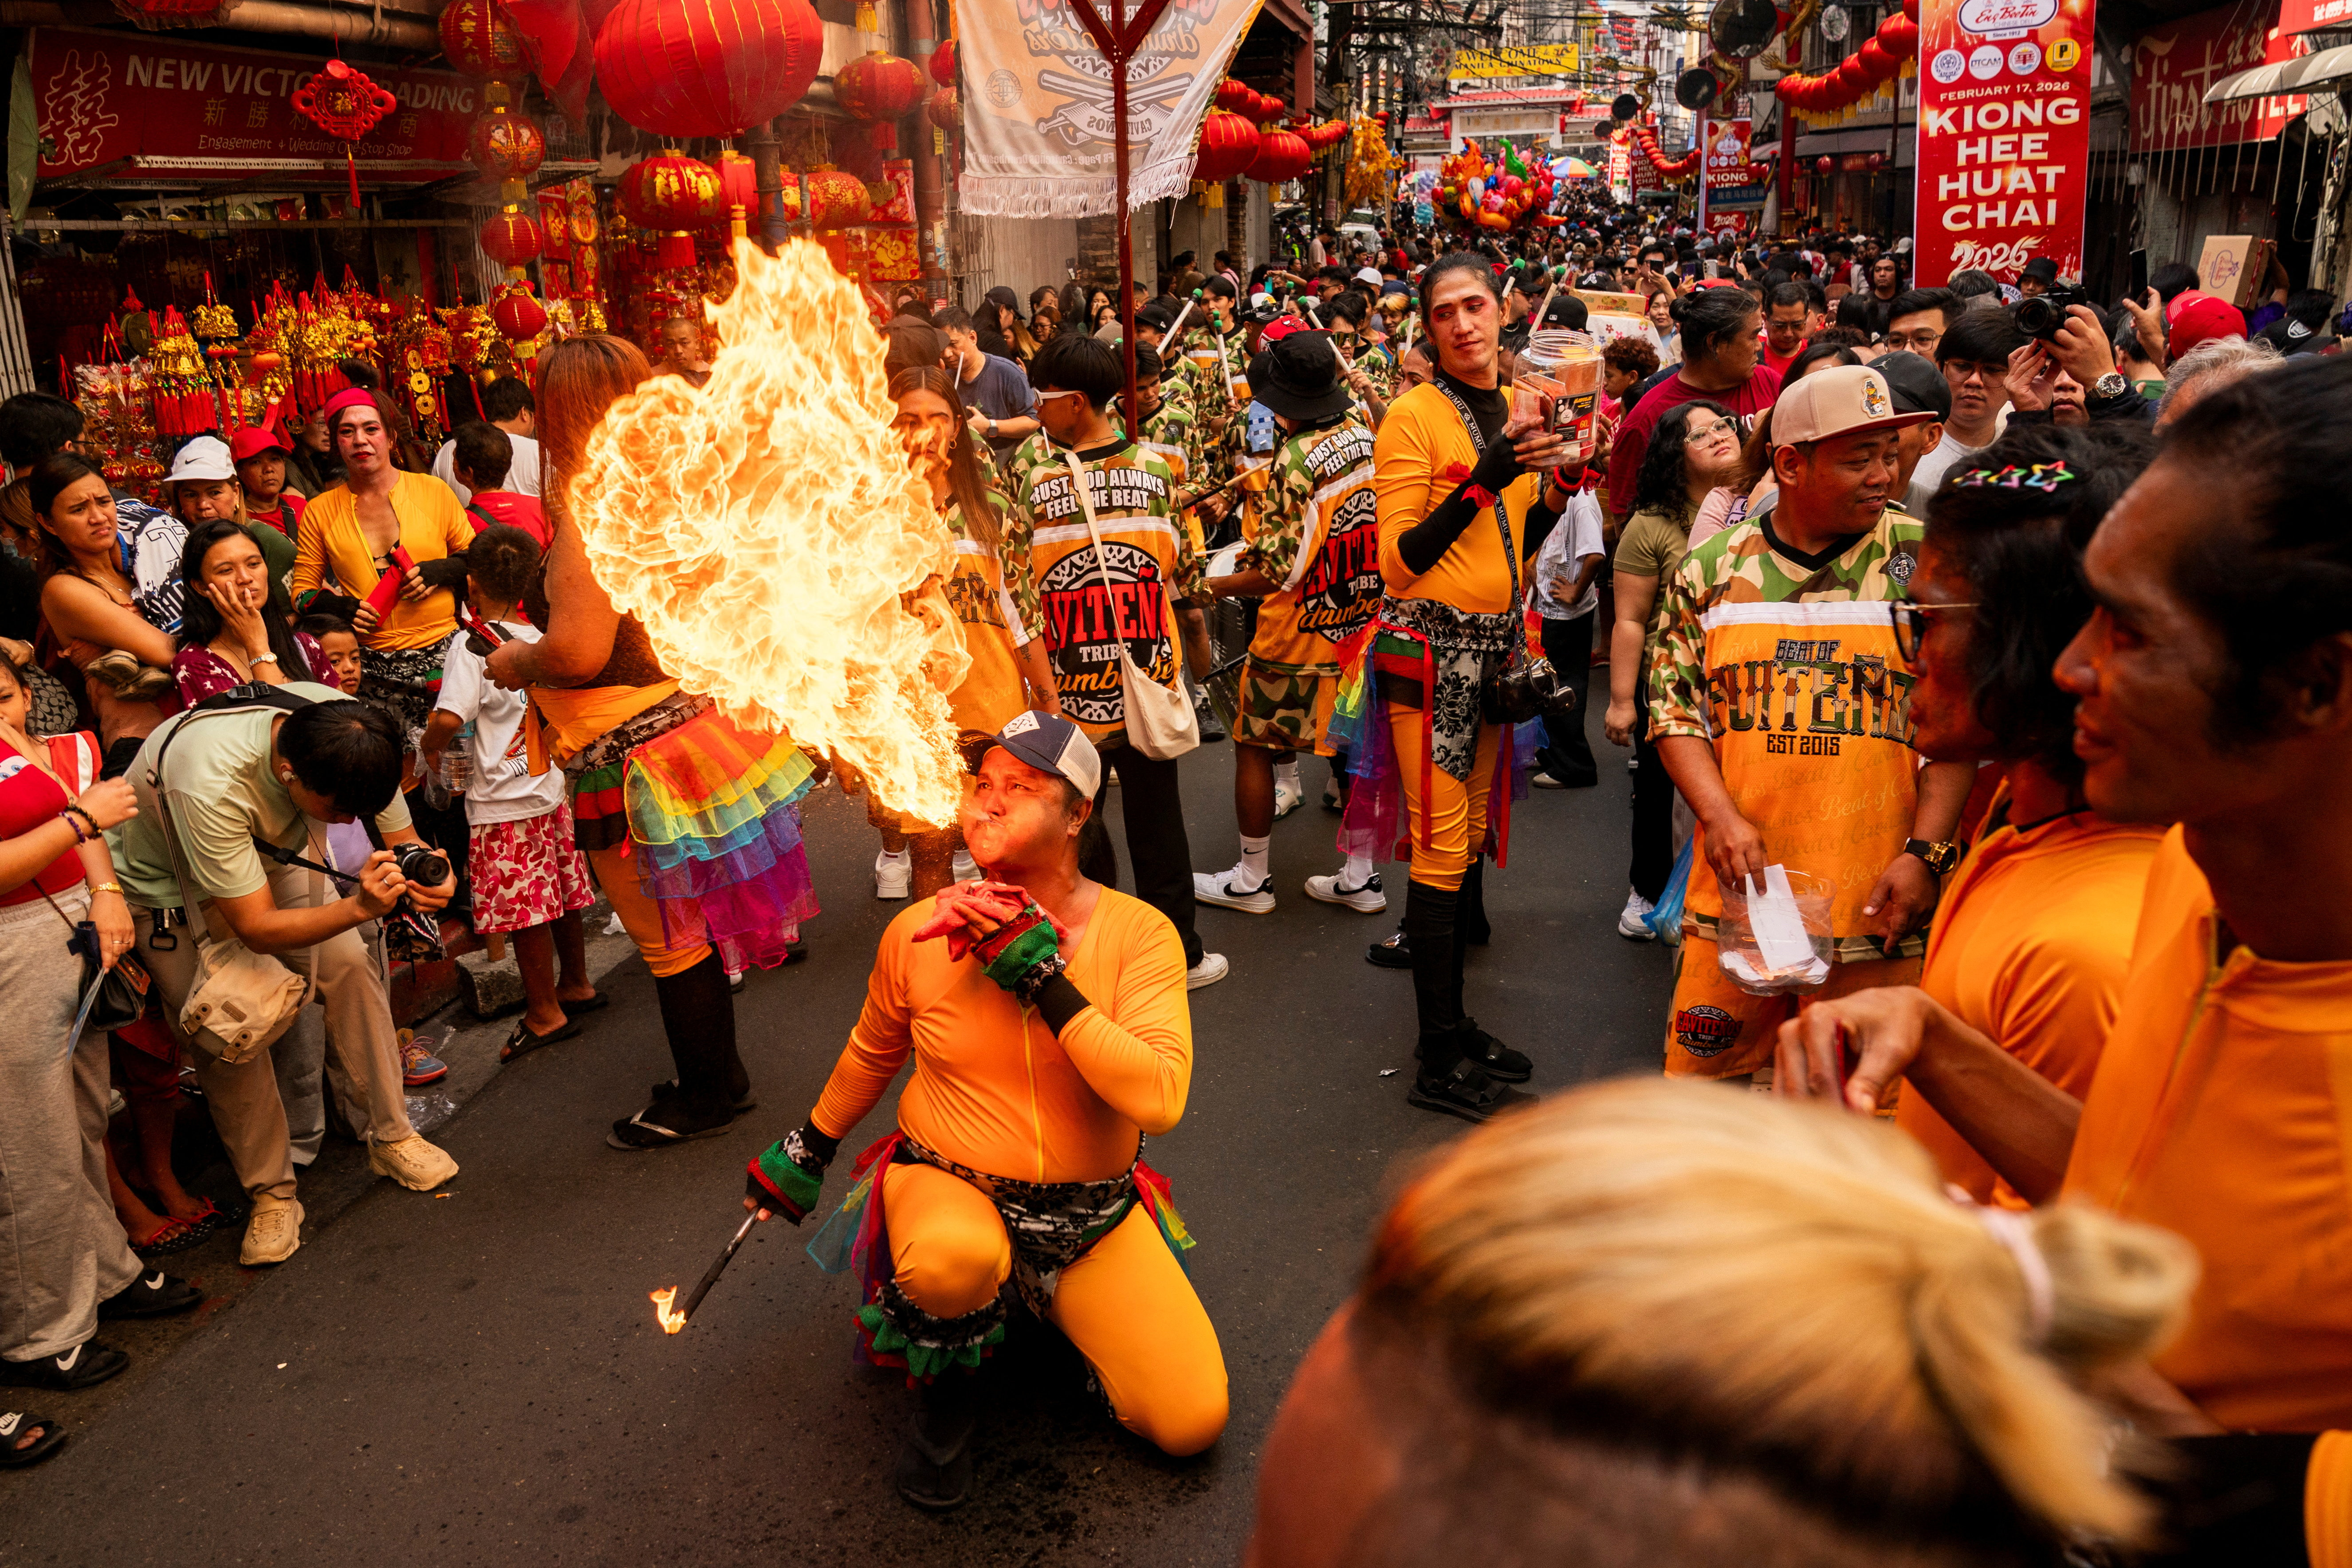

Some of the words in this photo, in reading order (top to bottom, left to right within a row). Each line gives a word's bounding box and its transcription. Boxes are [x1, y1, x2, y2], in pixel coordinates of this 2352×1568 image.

[126, 55, 214, 91] NEW
[1940, 84, 2011, 102] FEBRUARY
[2016, 83, 2032, 93] 17,
[2036, 81, 2070, 92] 2026
[1927, 96, 2081, 138] KIONG
[198, 134, 272, 150] Engagement
[289, 137, 335, 153] Wedding
[387, 142, 413, 157] Shop
[1956, 131, 2049, 167] HEE
[1707, 172, 1748, 183] KIONG
[1938, 164, 2066, 202] HUAT
[1942, 199, 2057, 232] CHAI
[1947, 235, 2047, 284] 2026
[1443, 387, 1464, 409] MUMU
[1303, 437, 1335, 472] TRUST
[1331, 429, 1356, 448] GOD
[1469, 422, 1484, 449] MUMU
[1323, 451, 1346, 478] FEEL
[1342, 442, 1361, 462] THE
[1074, 470, 1106, 491] OD
[1109, 469, 1166, 497] ALWAYS
[1046, 495, 1079, 520] FEEL
[1111, 488, 1149, 509] BEAT
[1497, 506, 1509, 533] MUMU
[1774, 639, 1817, 662] BEAT
[1816, 639, 1841, 661] OF
[1767, 734, 1797, 754] EST
[1799, 735, 1841, 756] 2015
